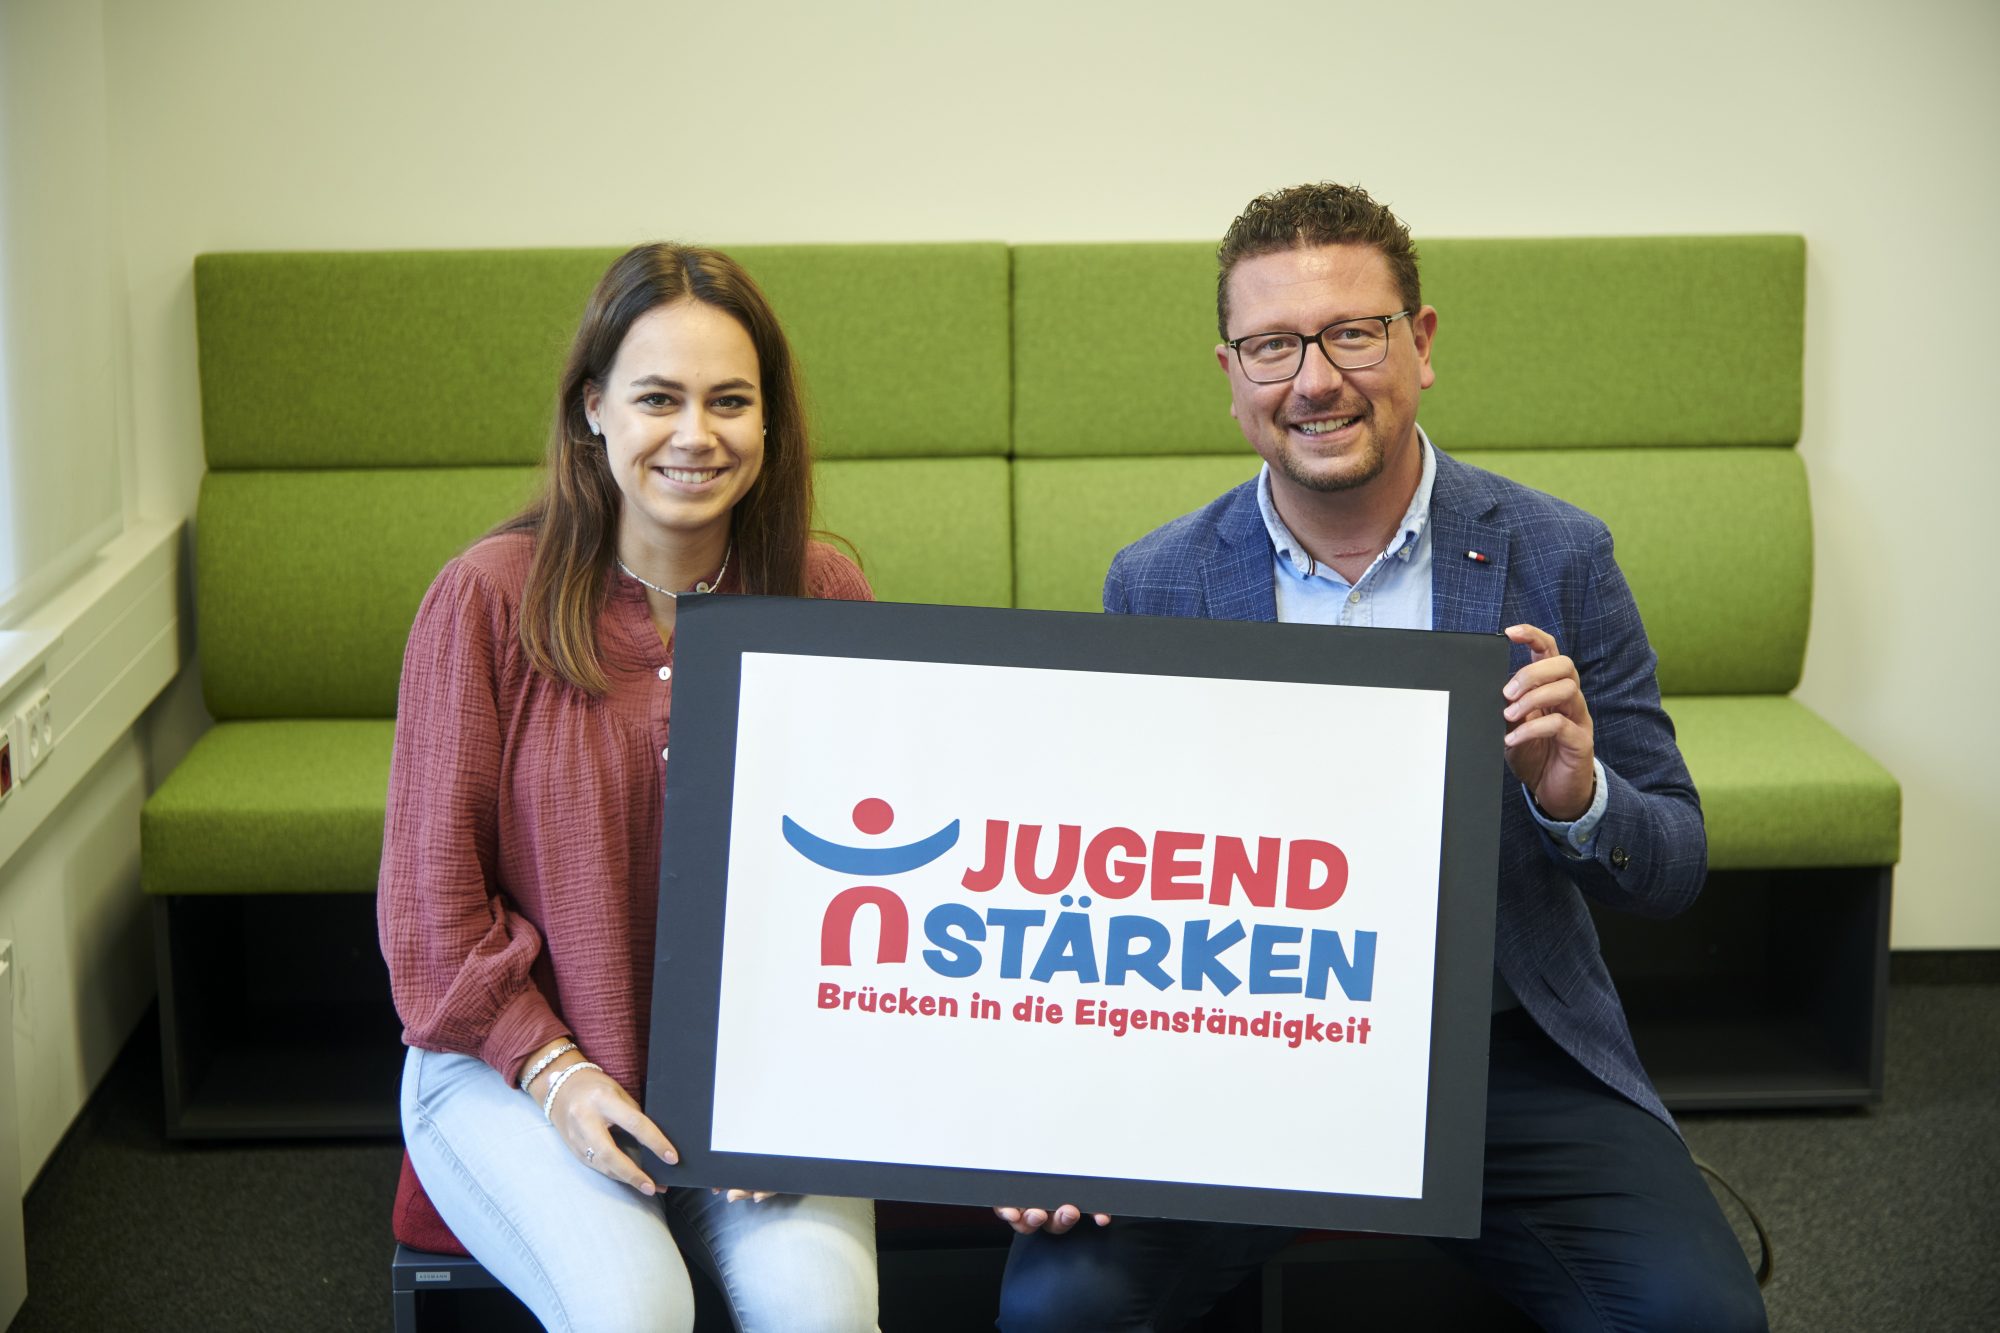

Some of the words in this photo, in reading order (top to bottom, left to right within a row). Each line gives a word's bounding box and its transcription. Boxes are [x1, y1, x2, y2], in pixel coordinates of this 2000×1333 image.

[961, 818, 1349, 911] JUGEND
[922, 894, 1378, 1003] STÄRKEN
[817, 982, 959, 1018] Brücken
[970, 991, 1001, 1021] in
[1012, 995, 1064, 1024] die
[1075, 999, 1372, 1049] Eigenständigkeit
